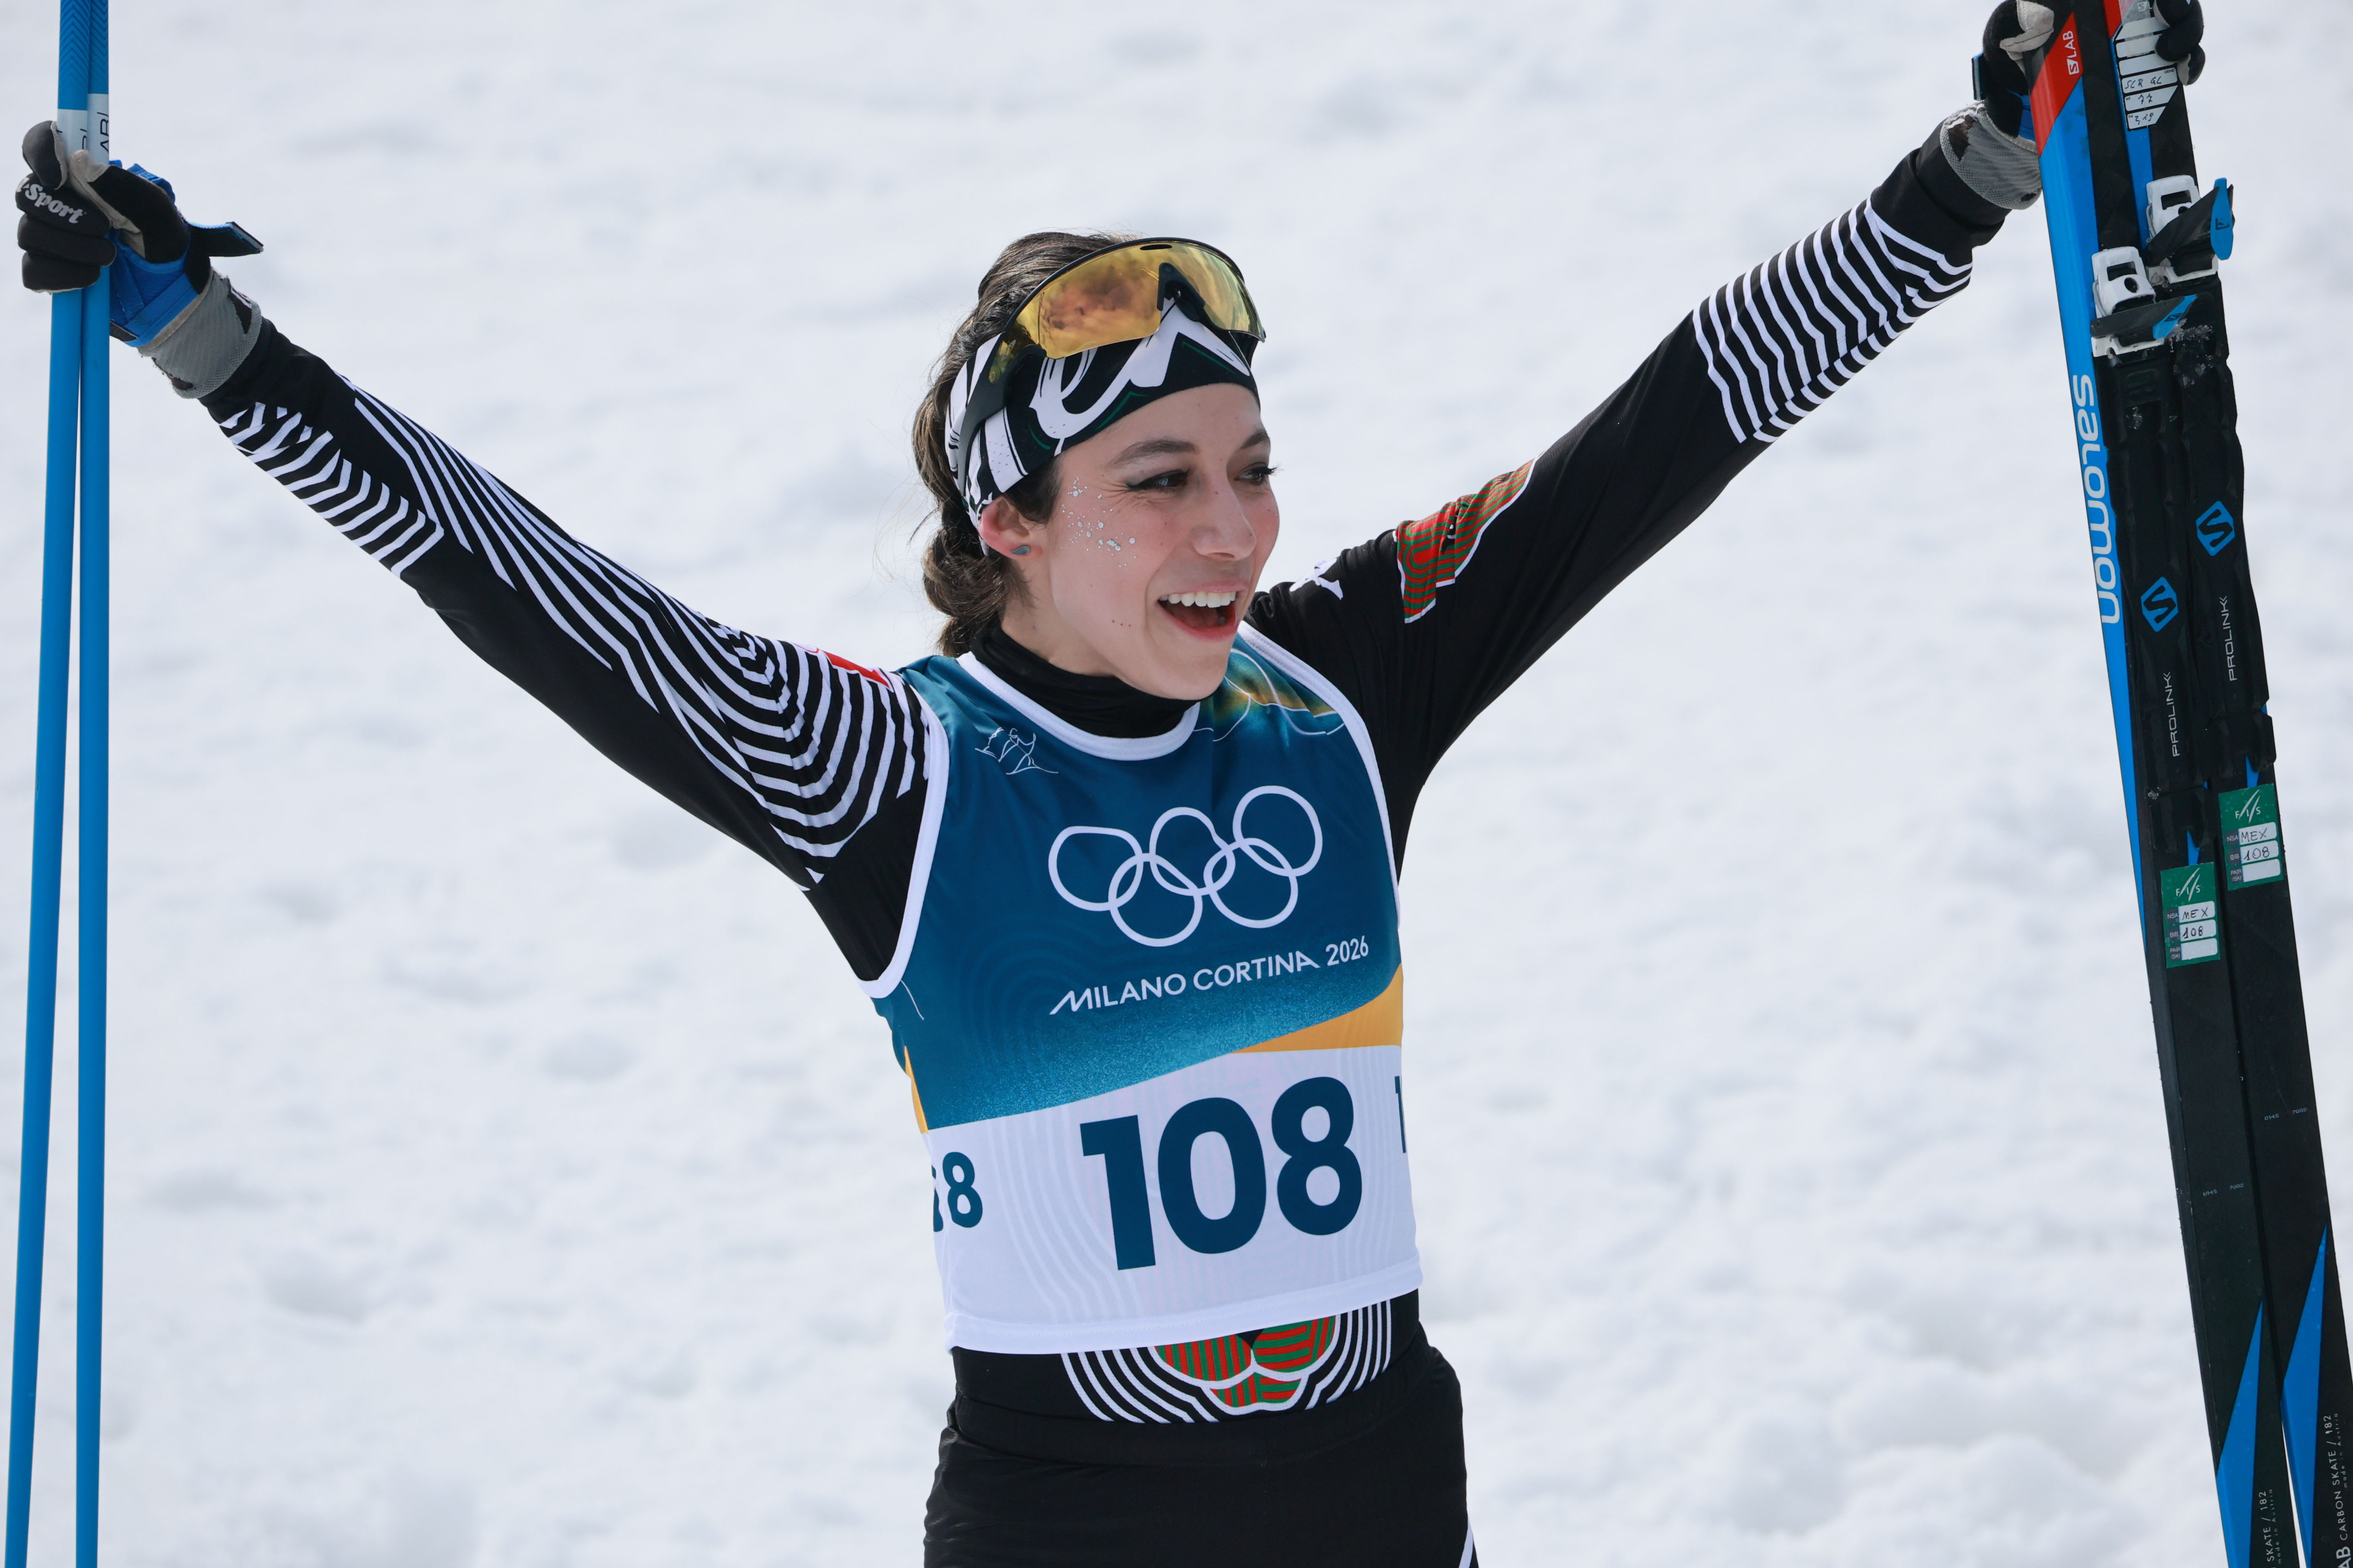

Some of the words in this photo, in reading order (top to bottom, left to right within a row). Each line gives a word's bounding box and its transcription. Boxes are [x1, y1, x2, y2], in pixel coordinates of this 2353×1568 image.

[2241, 828, 2267, 843] MEX
[2243, 846, 2270, 860] 108
[2182, 906, 2208, 921] MEX
[2182, 926, 2203, 939] 108
[1049, 974, 1187, 1016] MILANO
[1193, 950, 1321, 991] CORTINA
[1325, 935, 1369, 967] 2026
[1080, 1076, 1362, 1271] 108
[2323, 1415, 2333, 1434] 182
[2328, 1451, 2340, 1486] SKATE
[2259, 1491, 2268, 1511] 182
[2334, 1491, 2348, 1541] CARBON
[2263, 1527, 2274, 1562] SKATE
